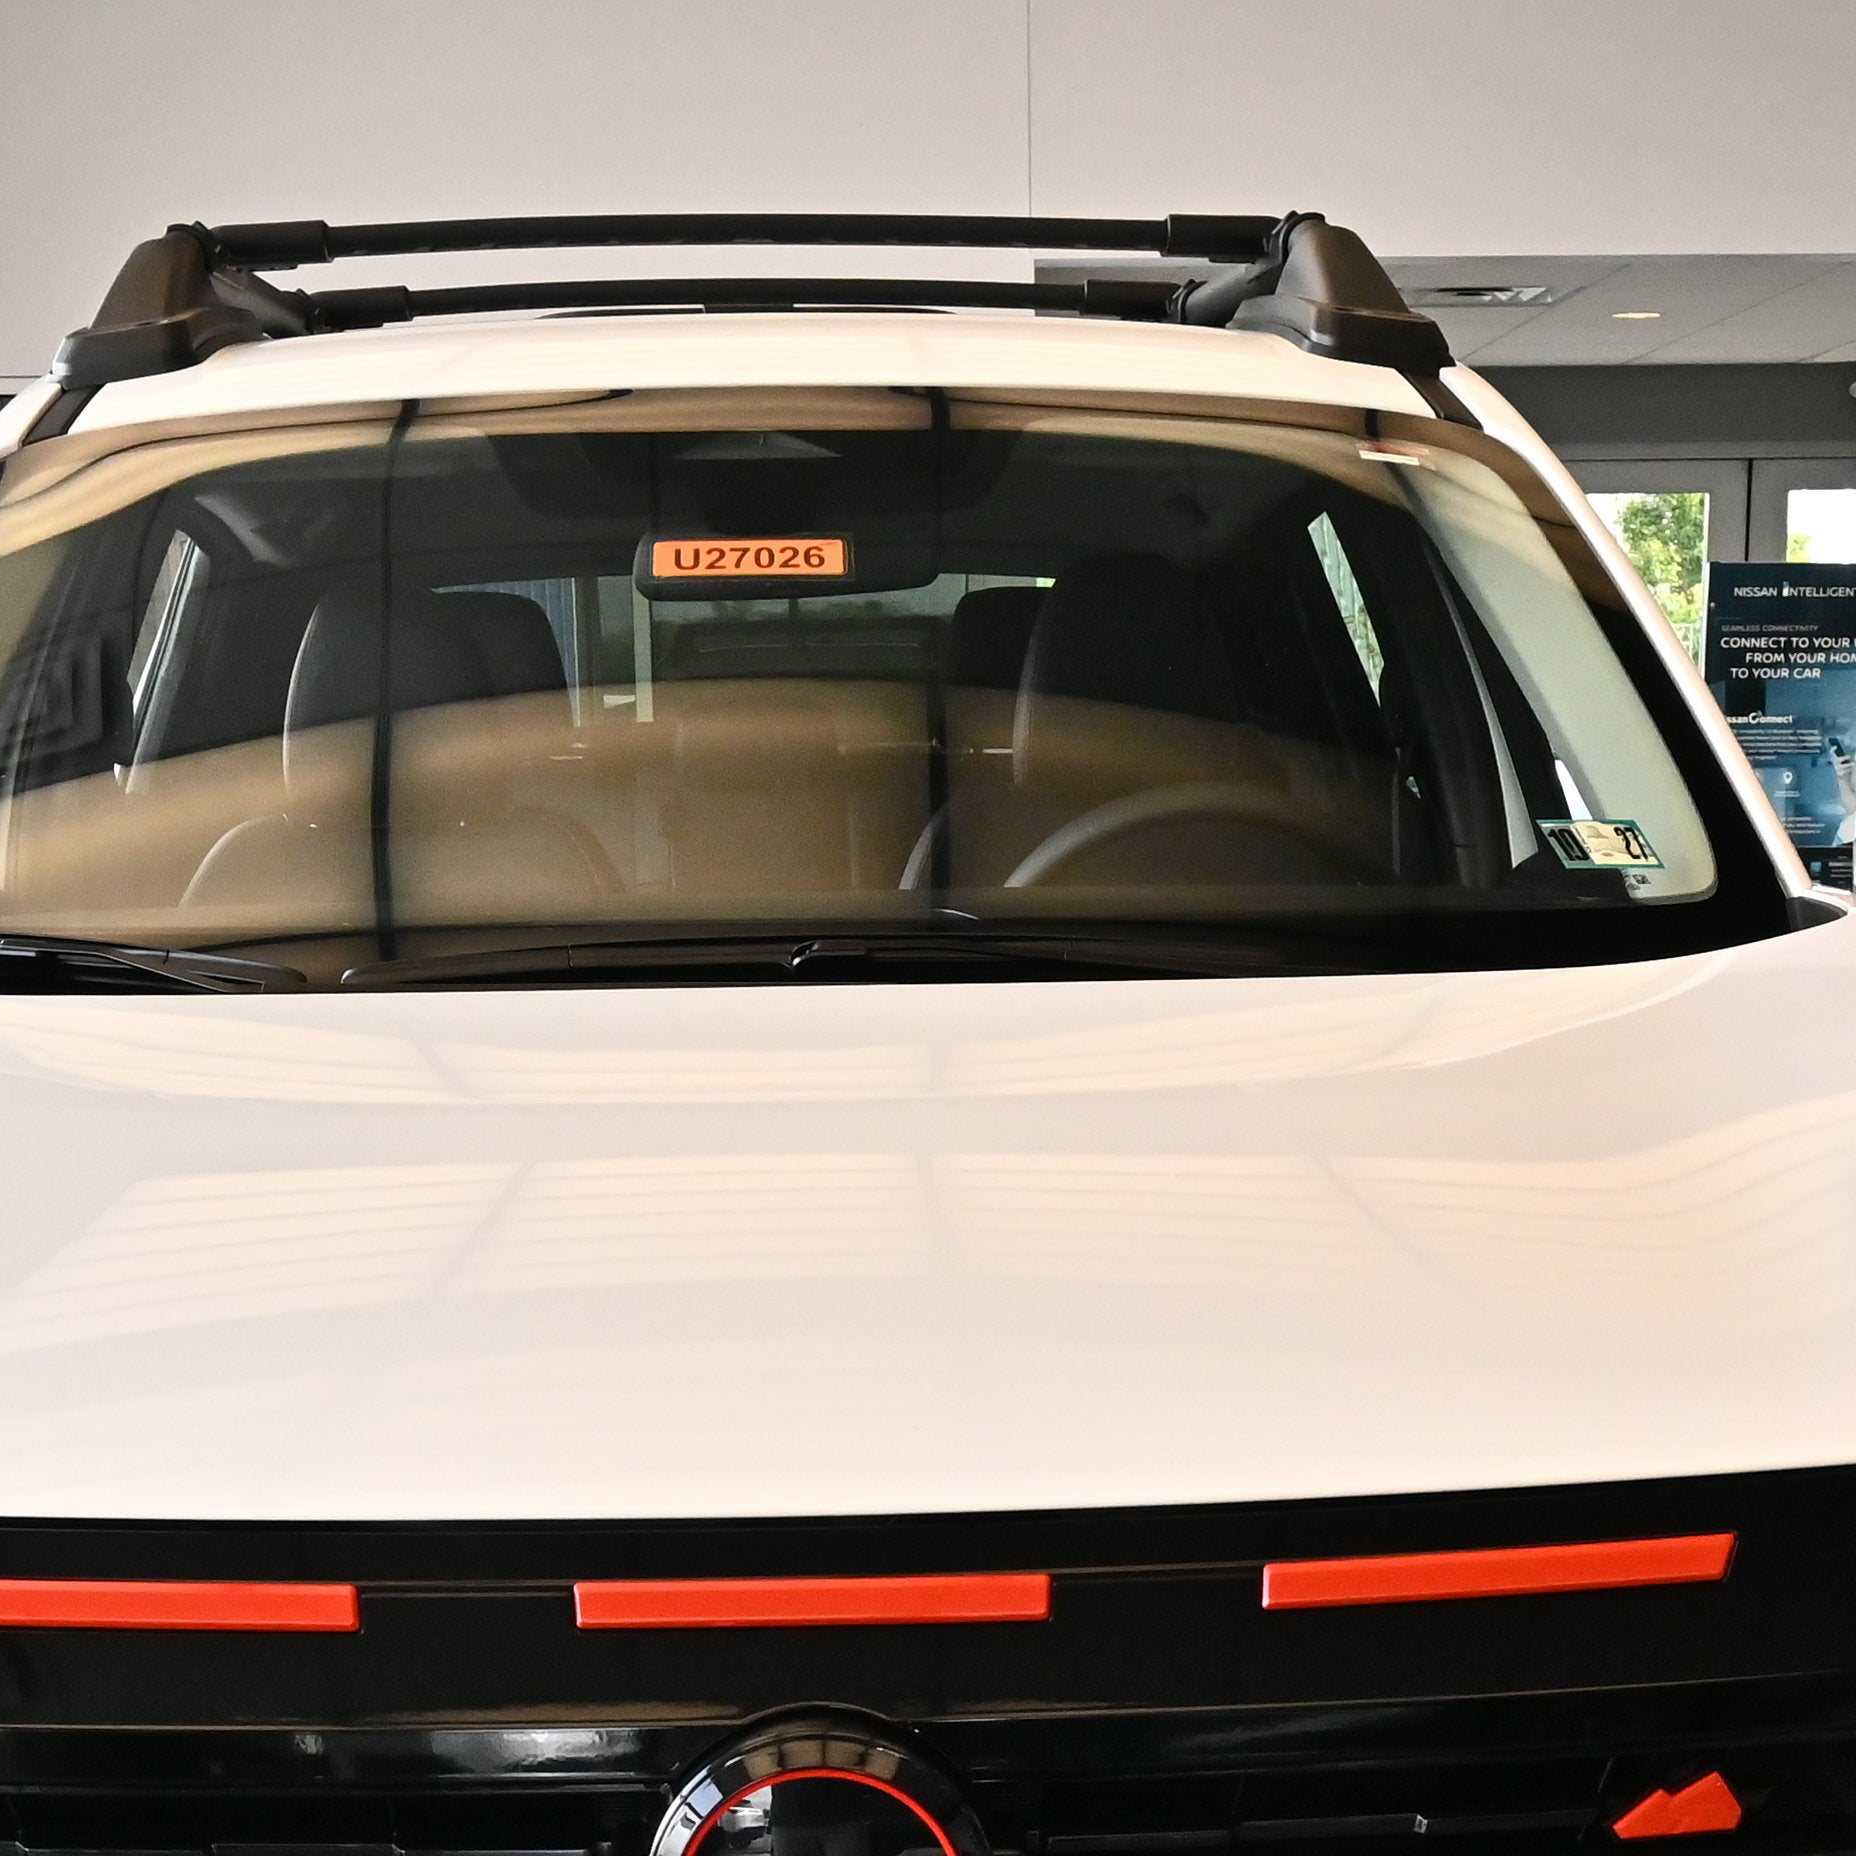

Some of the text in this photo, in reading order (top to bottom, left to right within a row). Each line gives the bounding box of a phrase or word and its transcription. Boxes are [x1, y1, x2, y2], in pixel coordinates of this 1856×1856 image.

[673, 546, 826, 571] U27026
[1733, 586, 1778, 598] NISSAN
[1720, 637, 1786, 649] CONNECT
[1791, 637, 1809, 649] TO
[1812, 637, 1850, 649] YOUR
[1745, 652, 1785, 664] FROM
[1787, 652, 1826, 664] YOUR
[1730, 667, 1822, 679] TO YOUR CAR
[1613, 826, 1649, 862] 27
